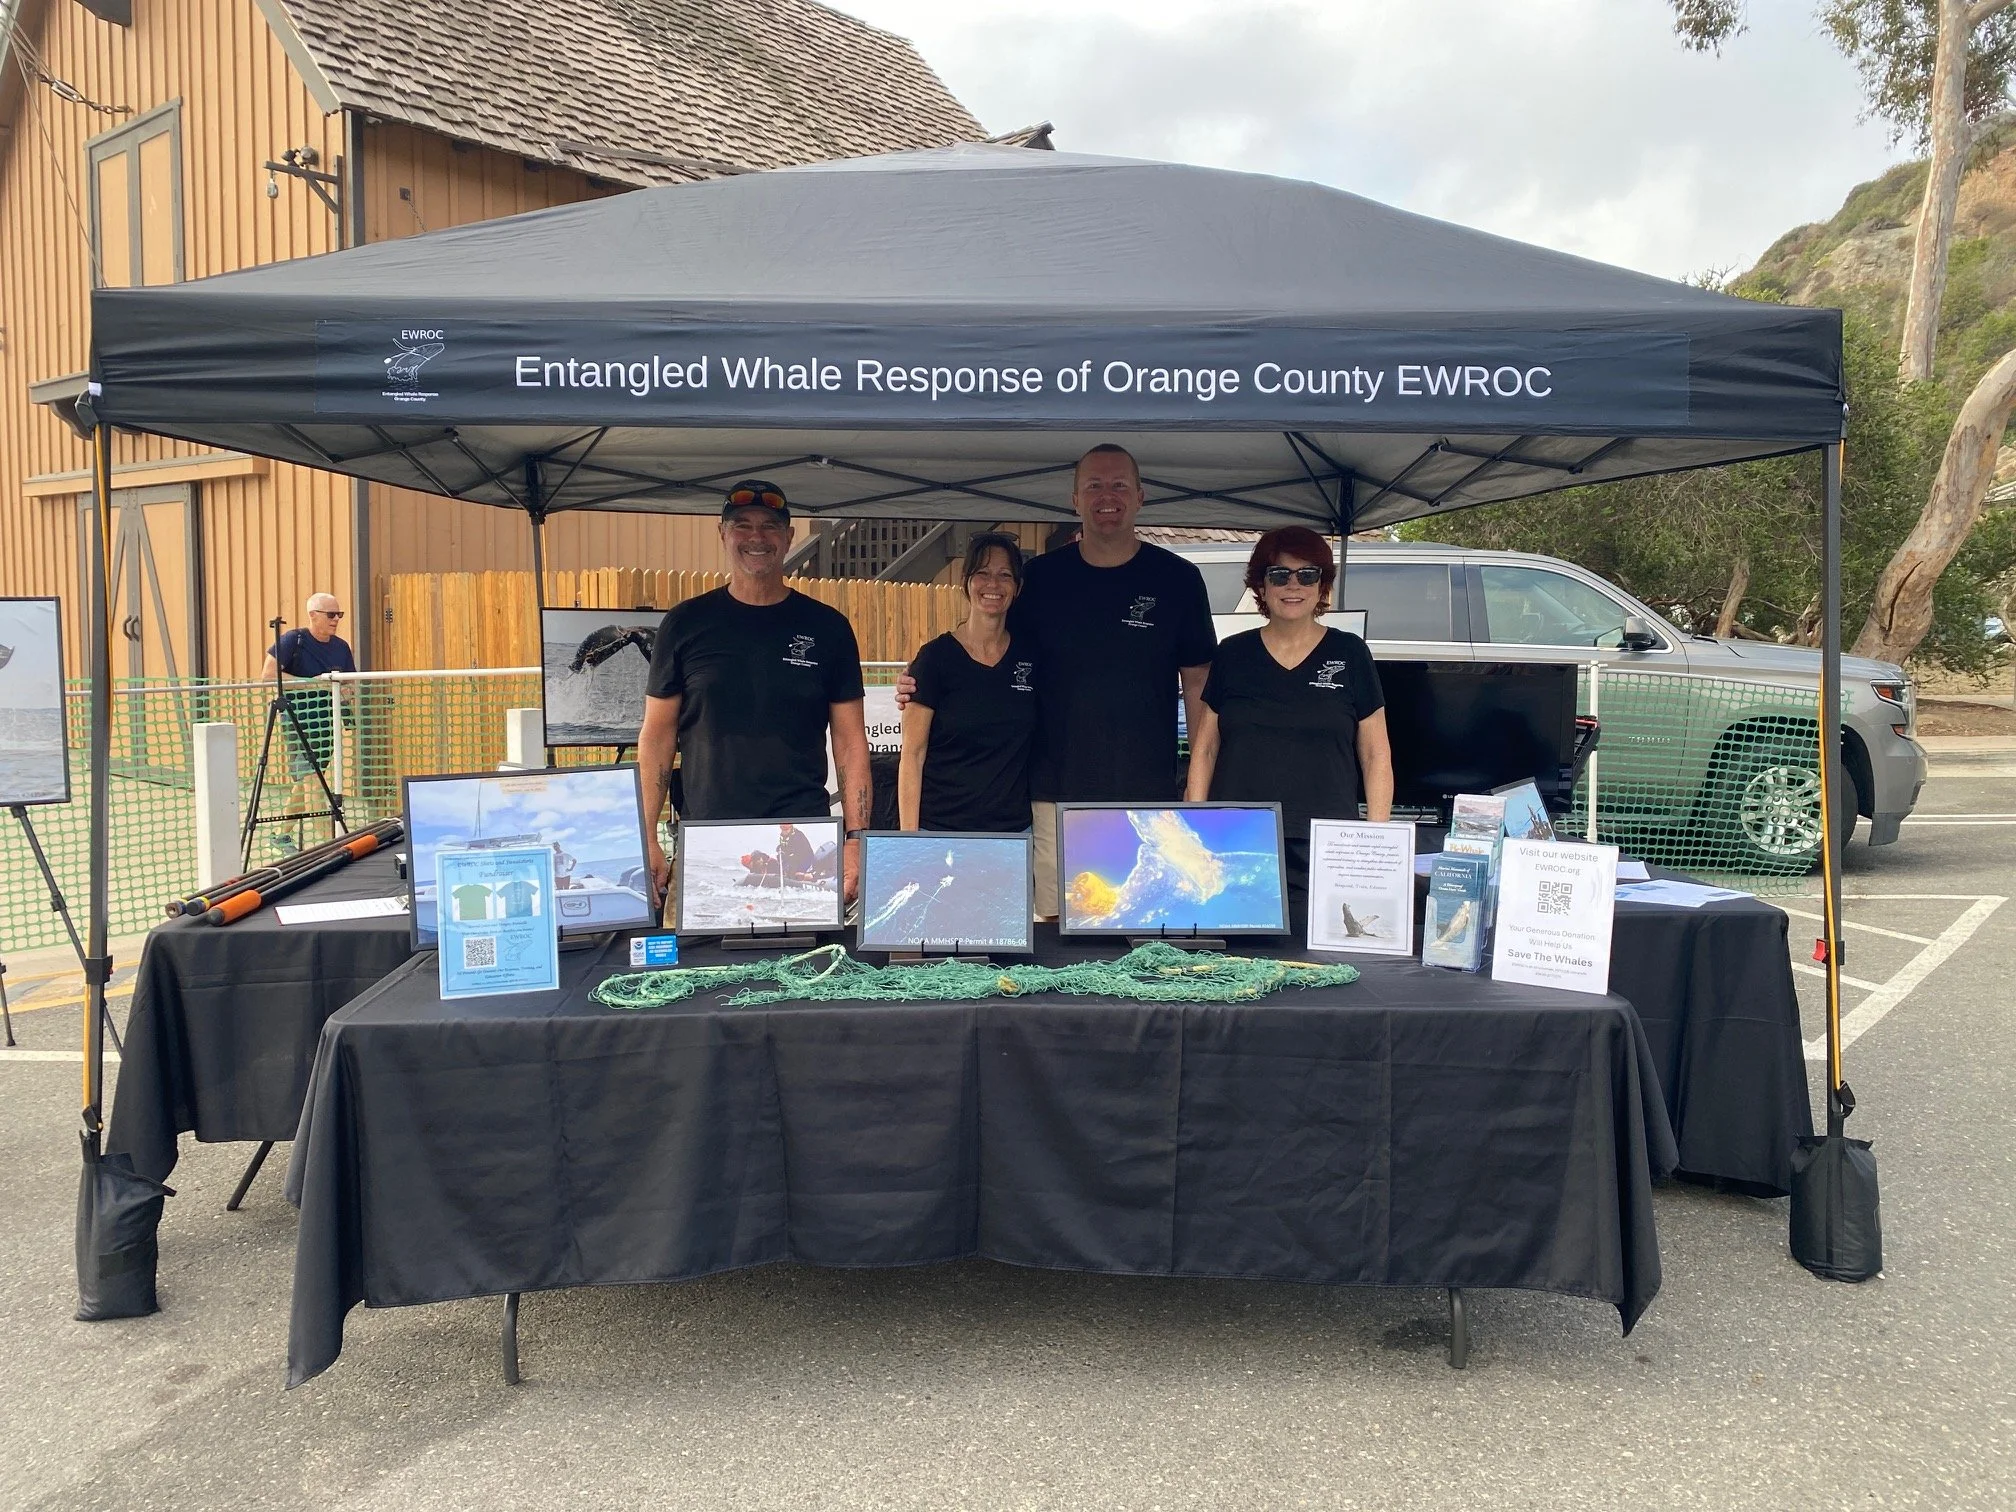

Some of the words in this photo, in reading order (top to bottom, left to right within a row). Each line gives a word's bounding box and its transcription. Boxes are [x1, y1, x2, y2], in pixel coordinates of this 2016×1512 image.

[401, 329, 444, 340] EWROC
[515, 355, 708, 397] Entangled
[720, 356, 842, 391] Whale
[857, 359, 1043, 401] Response
[1056, 359, 1092, 393] of
[1103, 361, 1240, 402] Orange
[1253, 362, 1385, 403] County
[1398, 365, 1552, 398] EWROC
[1340, 831, 1355, 839] Our
[1356, 832, 1385, 840] Mission
[1519, 847, 1540, 858] Visit
[1542, 850, 1558, 859] our
[1560, 850, 1599, 862] website
[1434, 871, 1472, 879] CALIFORNIA
[1534, 863, 1580, 876] EWROC.org
[1508, 924, 1525, 933] Your
[1525, 925, 1561, 938] Generous
[1561, 929, 1596, 941] Donation
[1528, 937, 1543, 947] Will
[1543, 940, 1561, 950] Help
[1562, 941, 1573, 950] Us
[1507, 948, 1532, 960] Save
[1533, 951, 1552, 962] The
[1554, 953, 1593, 968] Whales
